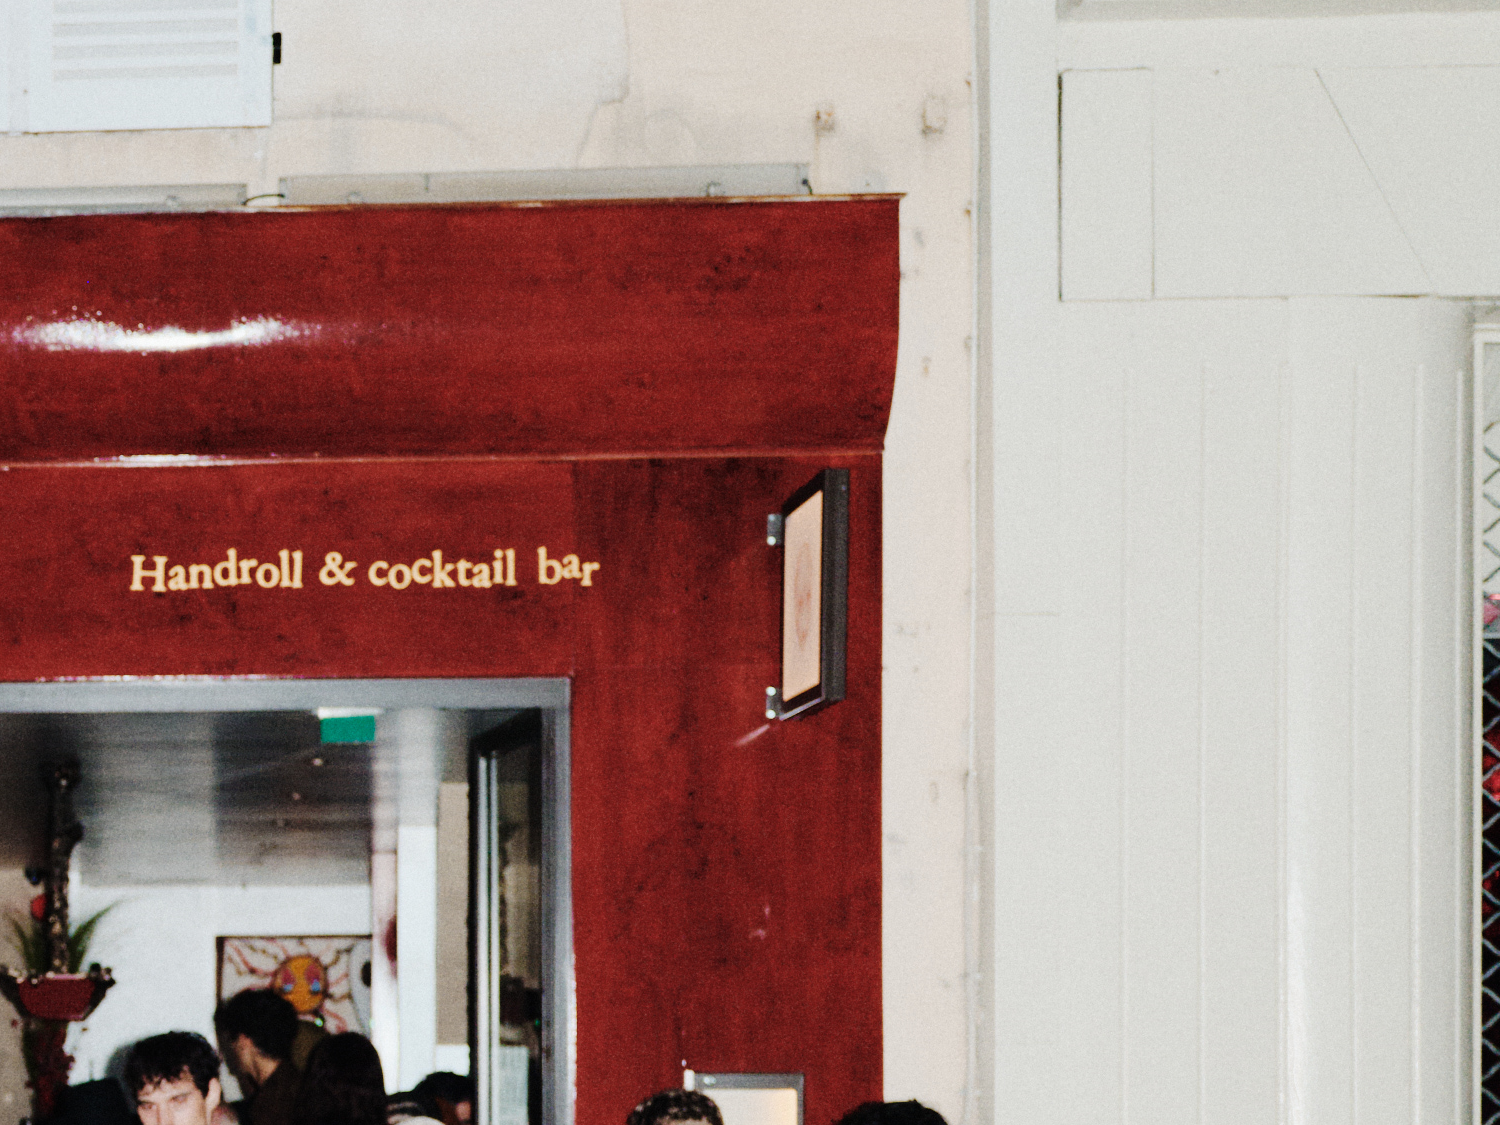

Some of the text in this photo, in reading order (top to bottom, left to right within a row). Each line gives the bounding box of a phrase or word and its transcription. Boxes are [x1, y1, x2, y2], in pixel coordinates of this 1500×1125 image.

[129, 546, 601, 593] Handroll & cocktail bar
